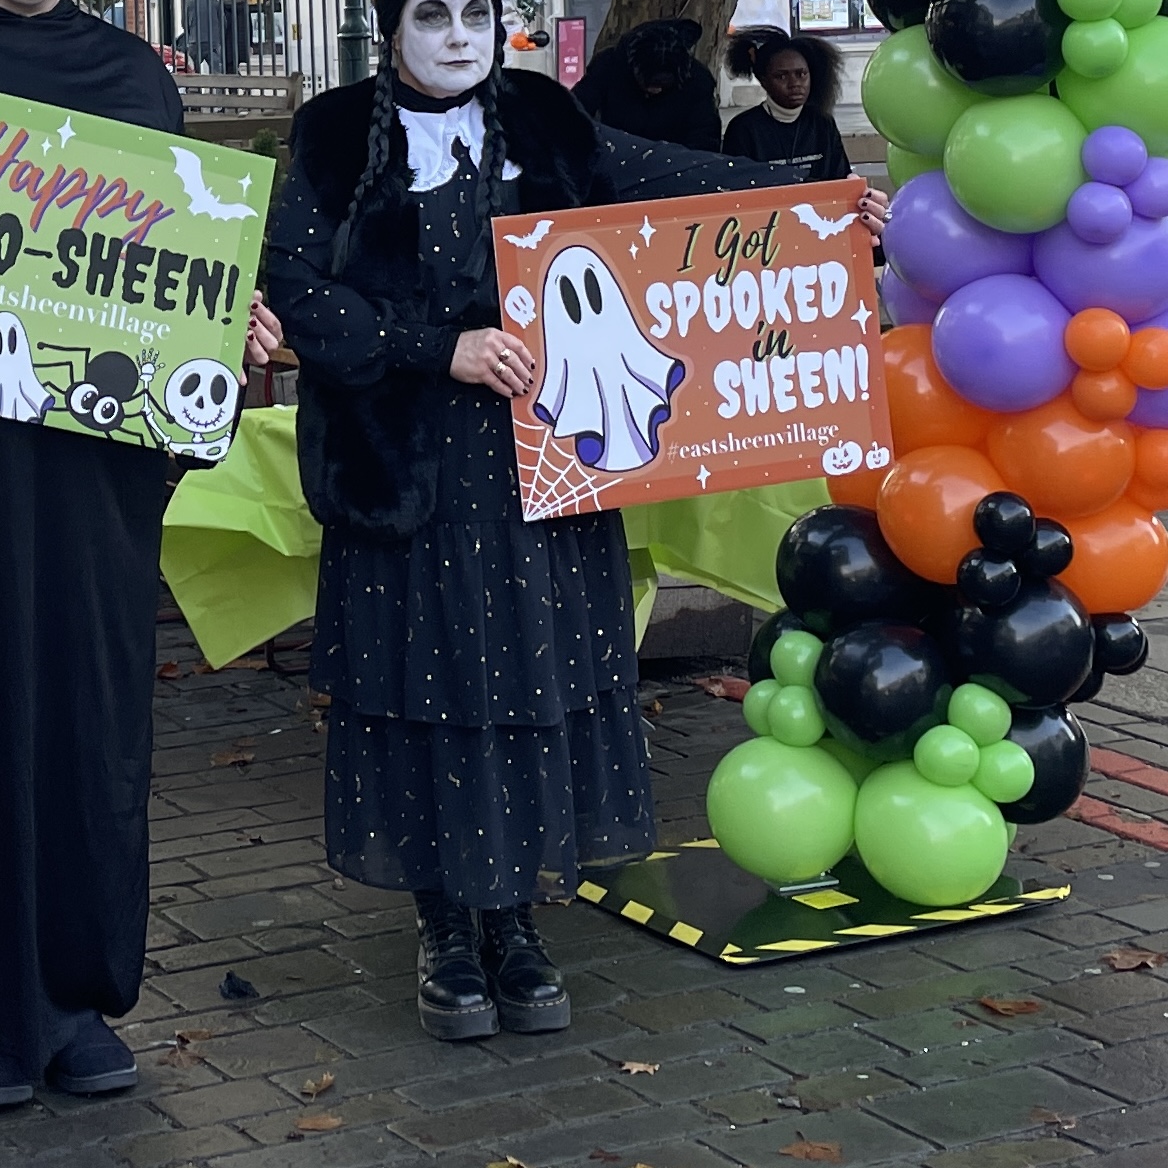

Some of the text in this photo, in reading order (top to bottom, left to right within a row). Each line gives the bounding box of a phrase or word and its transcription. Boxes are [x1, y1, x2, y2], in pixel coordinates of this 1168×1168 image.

[676, 210, 781, 287] I Got
[645, 261, 849, 338] SPOOKED
[752, 320, 796, 363] in
[713, 343, 869, 419] SHEEN!
[667, 422, 840, 464] #eastsheenvillage
